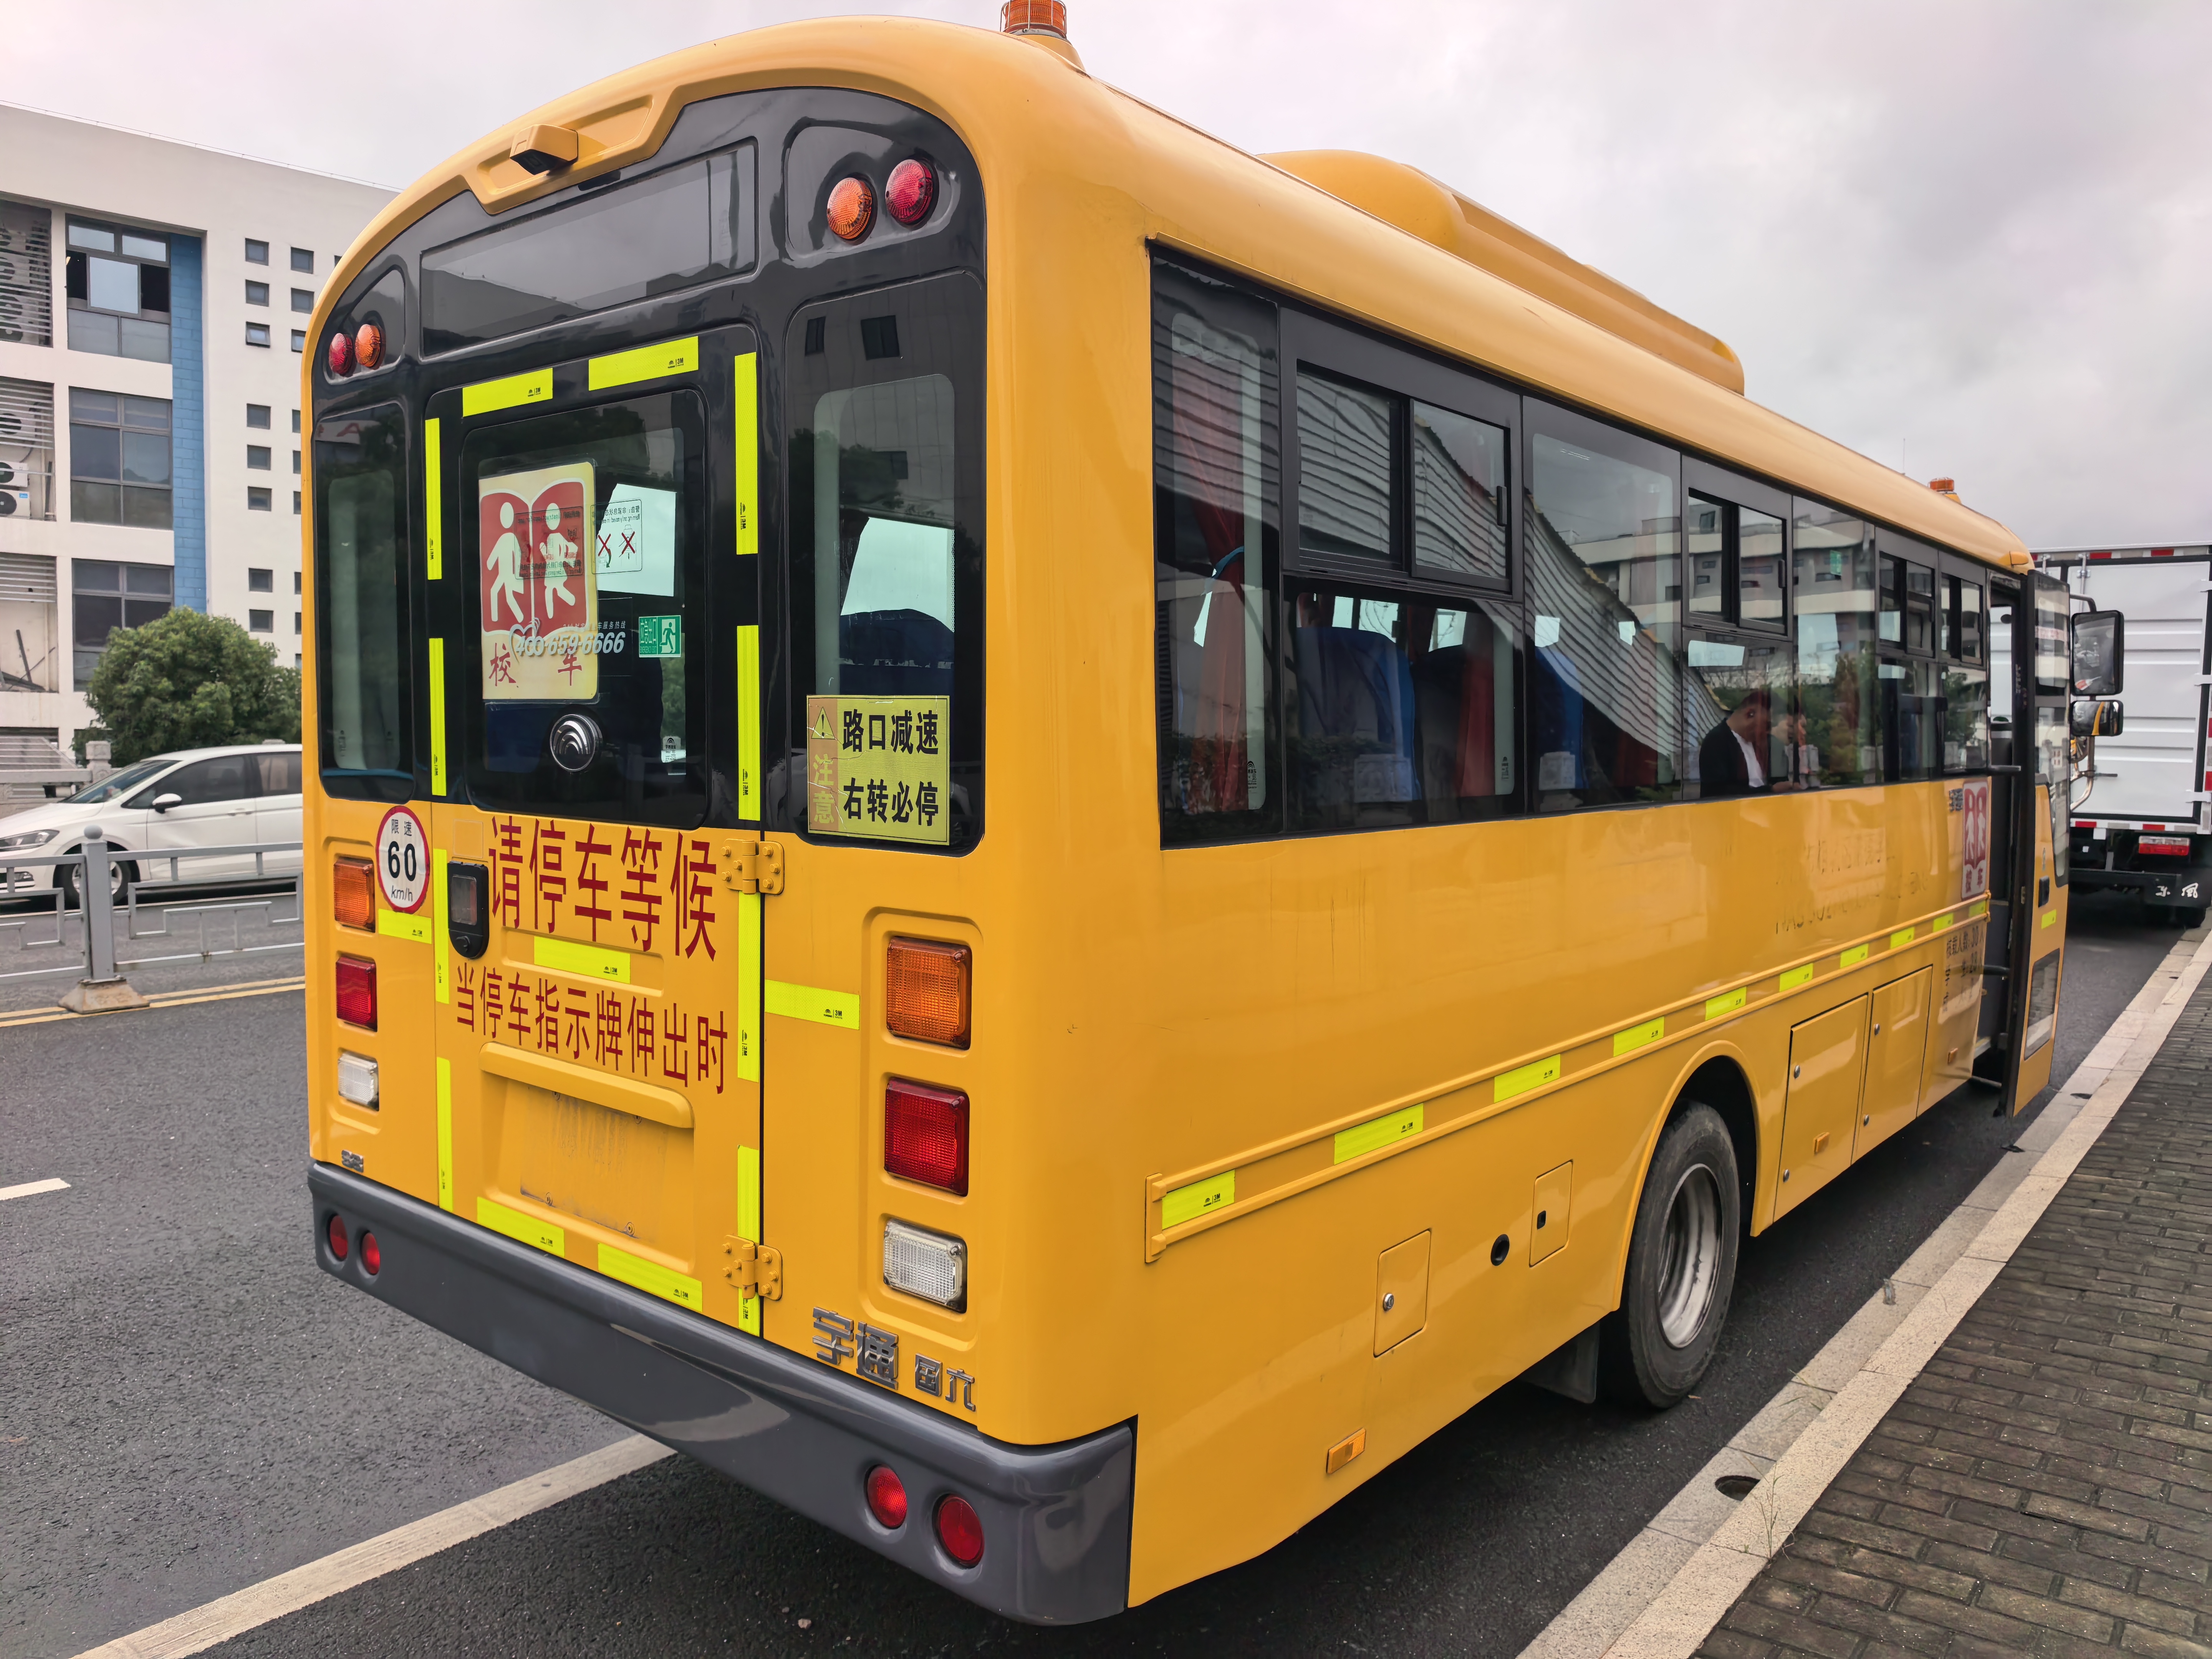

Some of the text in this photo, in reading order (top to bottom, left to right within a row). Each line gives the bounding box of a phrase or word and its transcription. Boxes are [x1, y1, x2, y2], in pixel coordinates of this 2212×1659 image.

[742, 518, 746, 529] 3M
[515, 631, 626, 656] 400-659-6666
[640, 619, 657, 644] 应急出口
[842, 709, 939, 755] 路口减速
[744, 785, 748, 795] 3M
[813, 753, 834, 824] 注意
[843, 777, 939, 827] 右转必停
[391, 819, 412, 836] 限速
[388, 841, 417, 882] 60
[391, 885, 413, 902] km/h
[488, 815, 717, 962] 请停车等候
[456, 962, 728, 1094] 当停车指示牌伸出时
[743, 1046, 747, 1056] 3M
[1214, 1193, 1220, 1201] 3M
[744, 1309, 748, 1320] 3M
[812, 1306, 976, 1412] 宇通 国六
